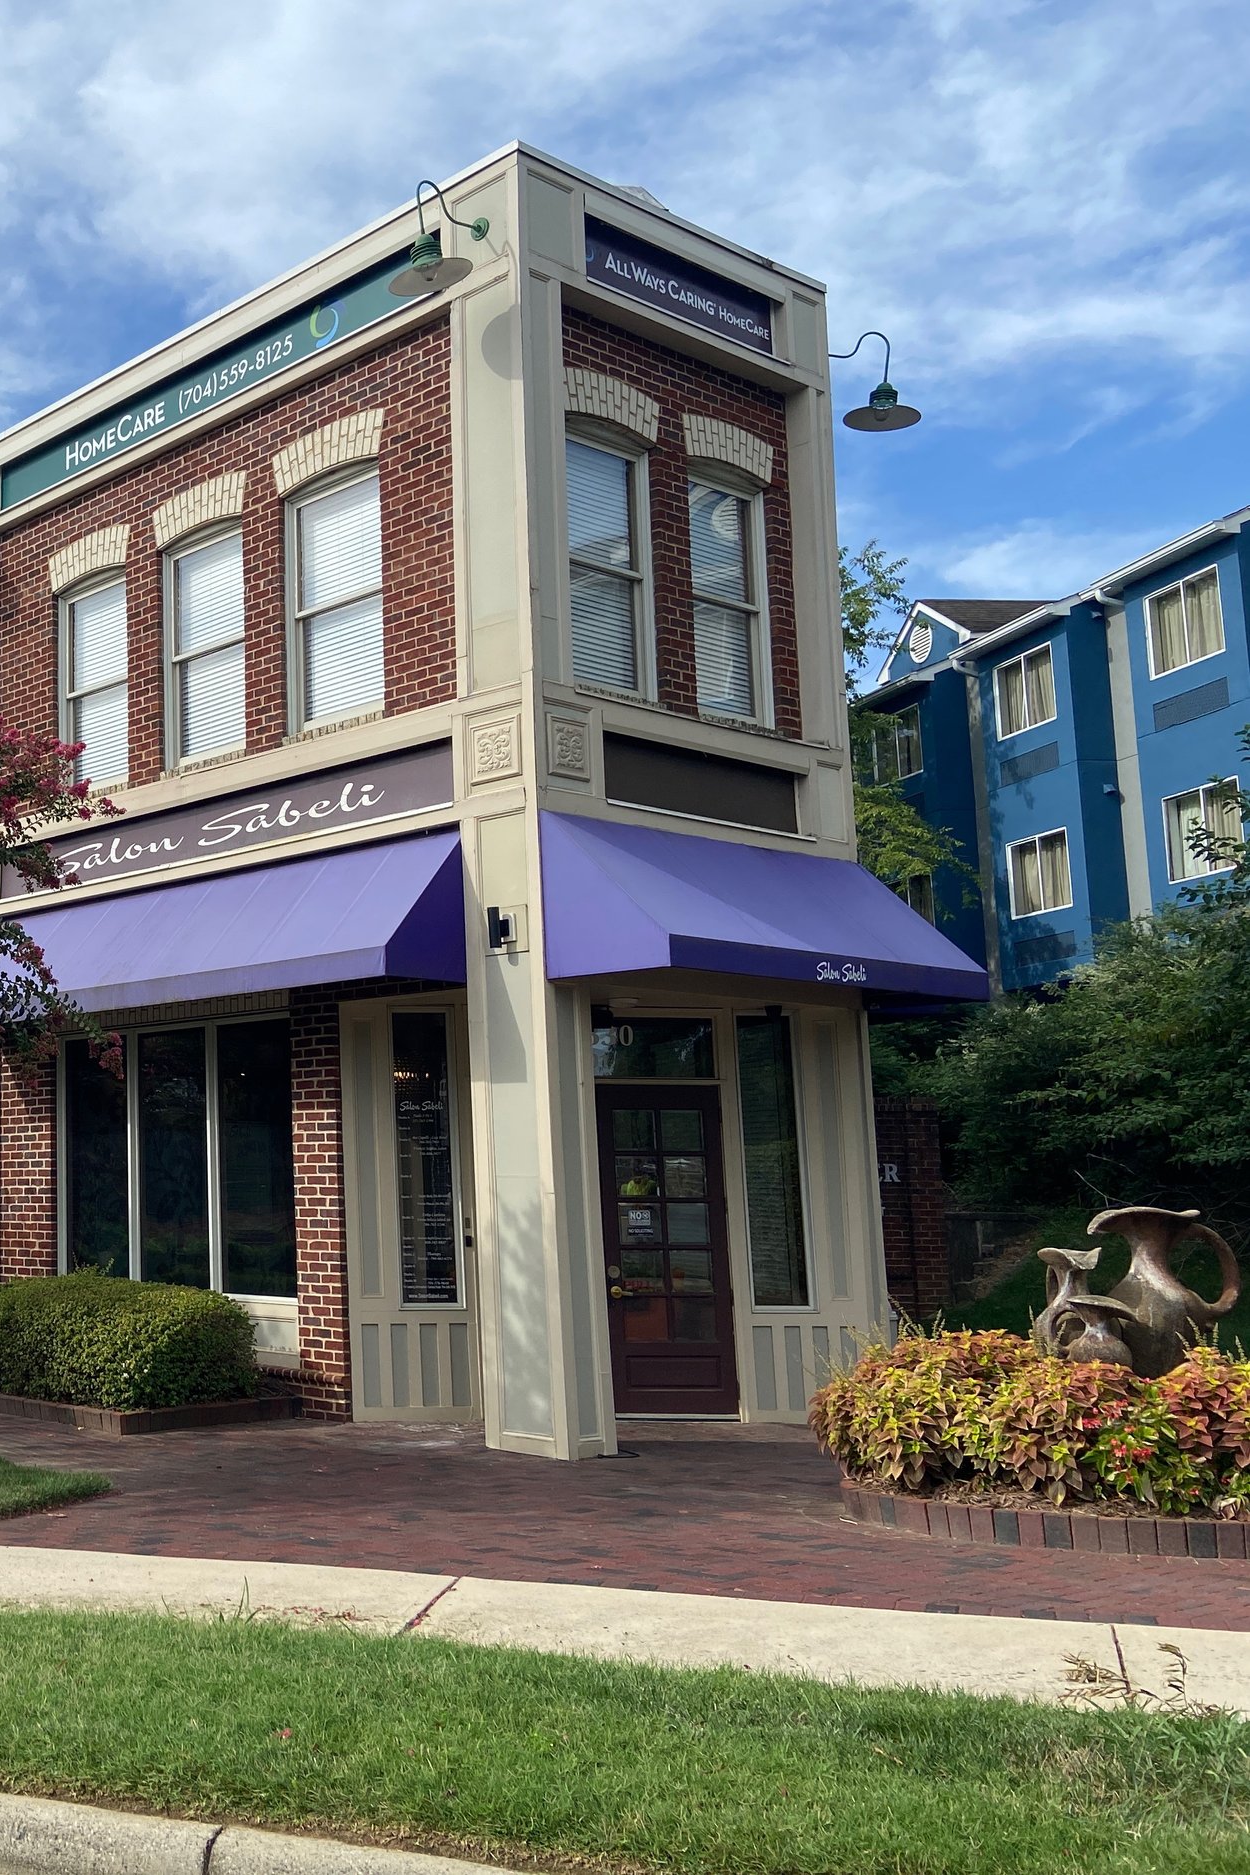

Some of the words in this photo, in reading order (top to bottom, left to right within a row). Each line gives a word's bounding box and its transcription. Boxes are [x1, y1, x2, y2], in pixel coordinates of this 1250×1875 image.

[719, 305, 770, 341] HOMECARE
[64, 401, 166, 471] HOMECARE
[55, 836, 184, 879] Salon
[198, 782, 386, 848] Sabeli
[816, 961, 840, 981] Salon
[841, 963, 867, 983] Sabeli
[630, 1211, 642, 1220] NO
